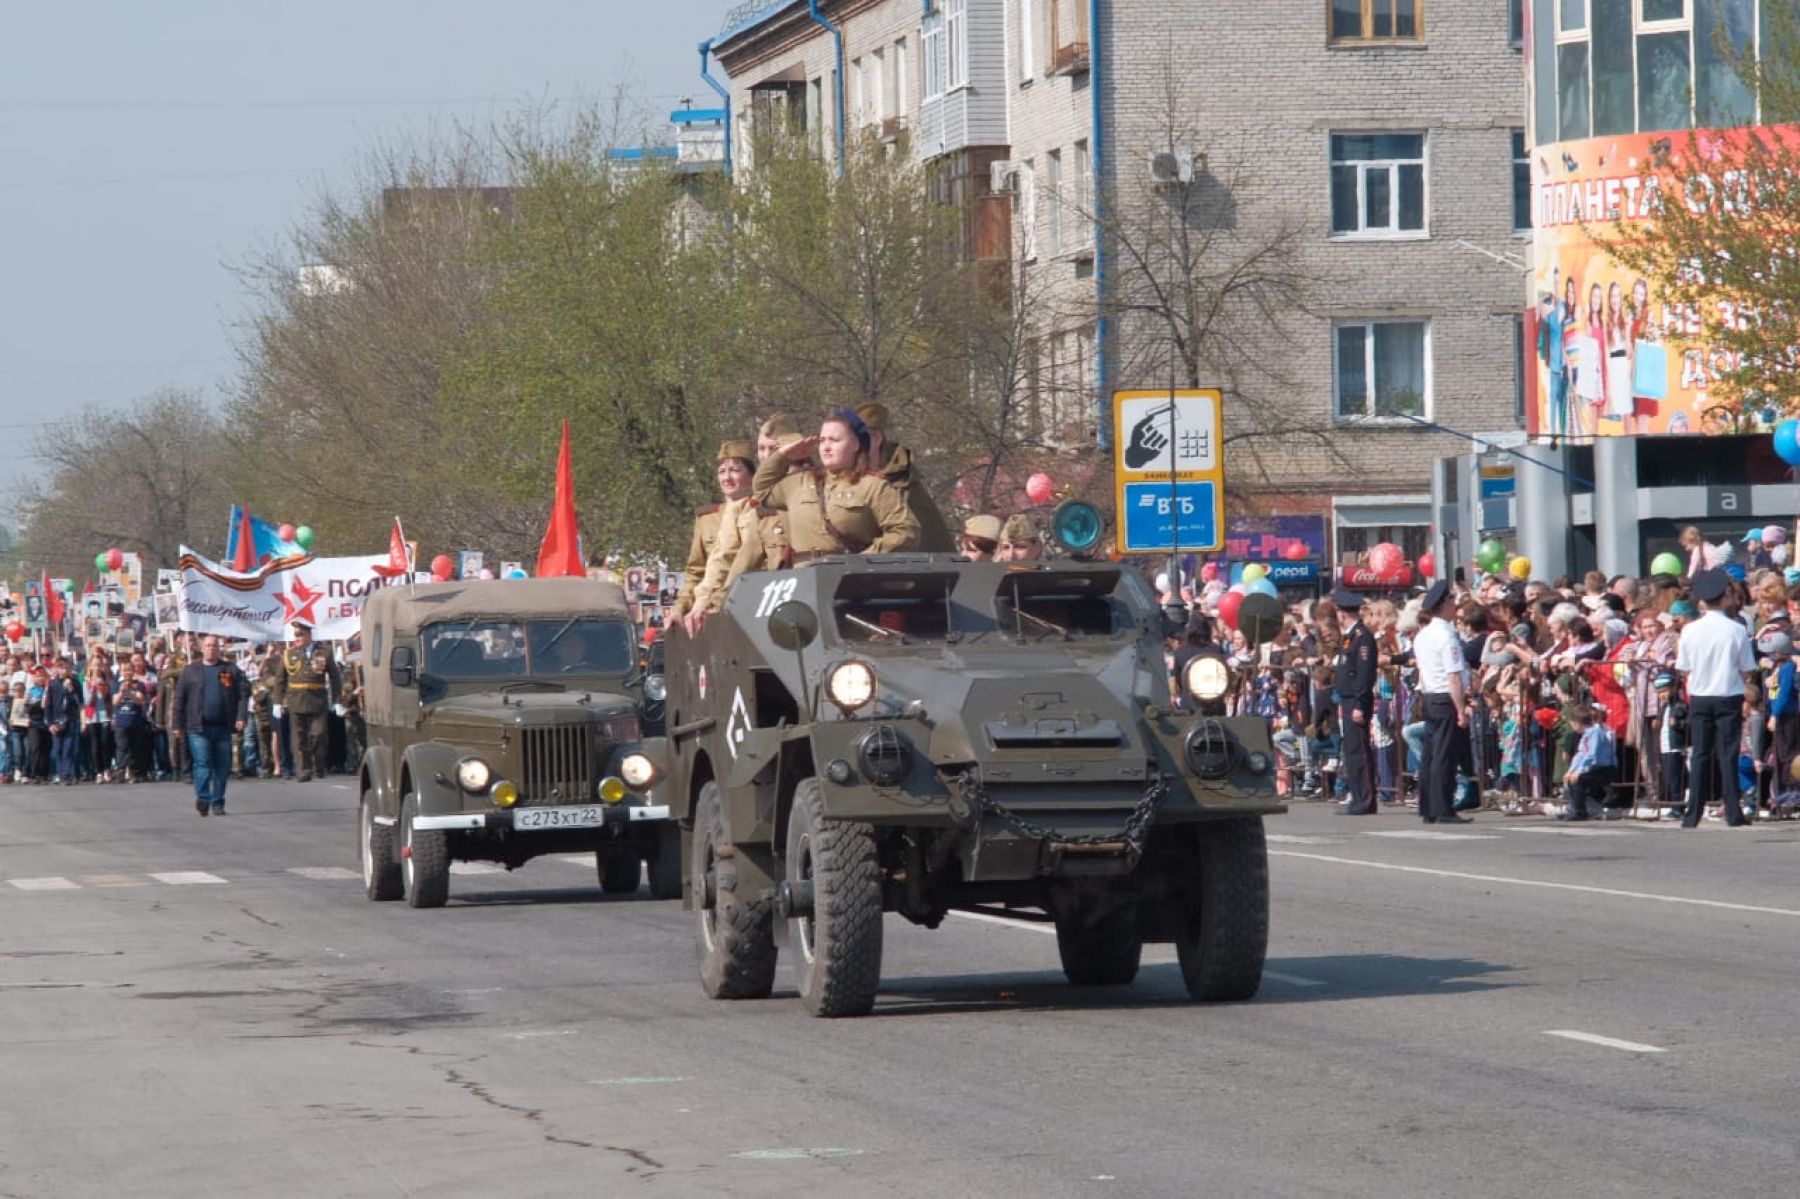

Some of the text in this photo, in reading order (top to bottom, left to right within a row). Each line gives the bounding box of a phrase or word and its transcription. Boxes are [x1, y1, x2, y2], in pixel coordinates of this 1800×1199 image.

[1540, 175, 1665, 227] ПЛАНЕТА
[1274, 564, 1309, 578] pepsi
[755, 577, 798, 618] 113
